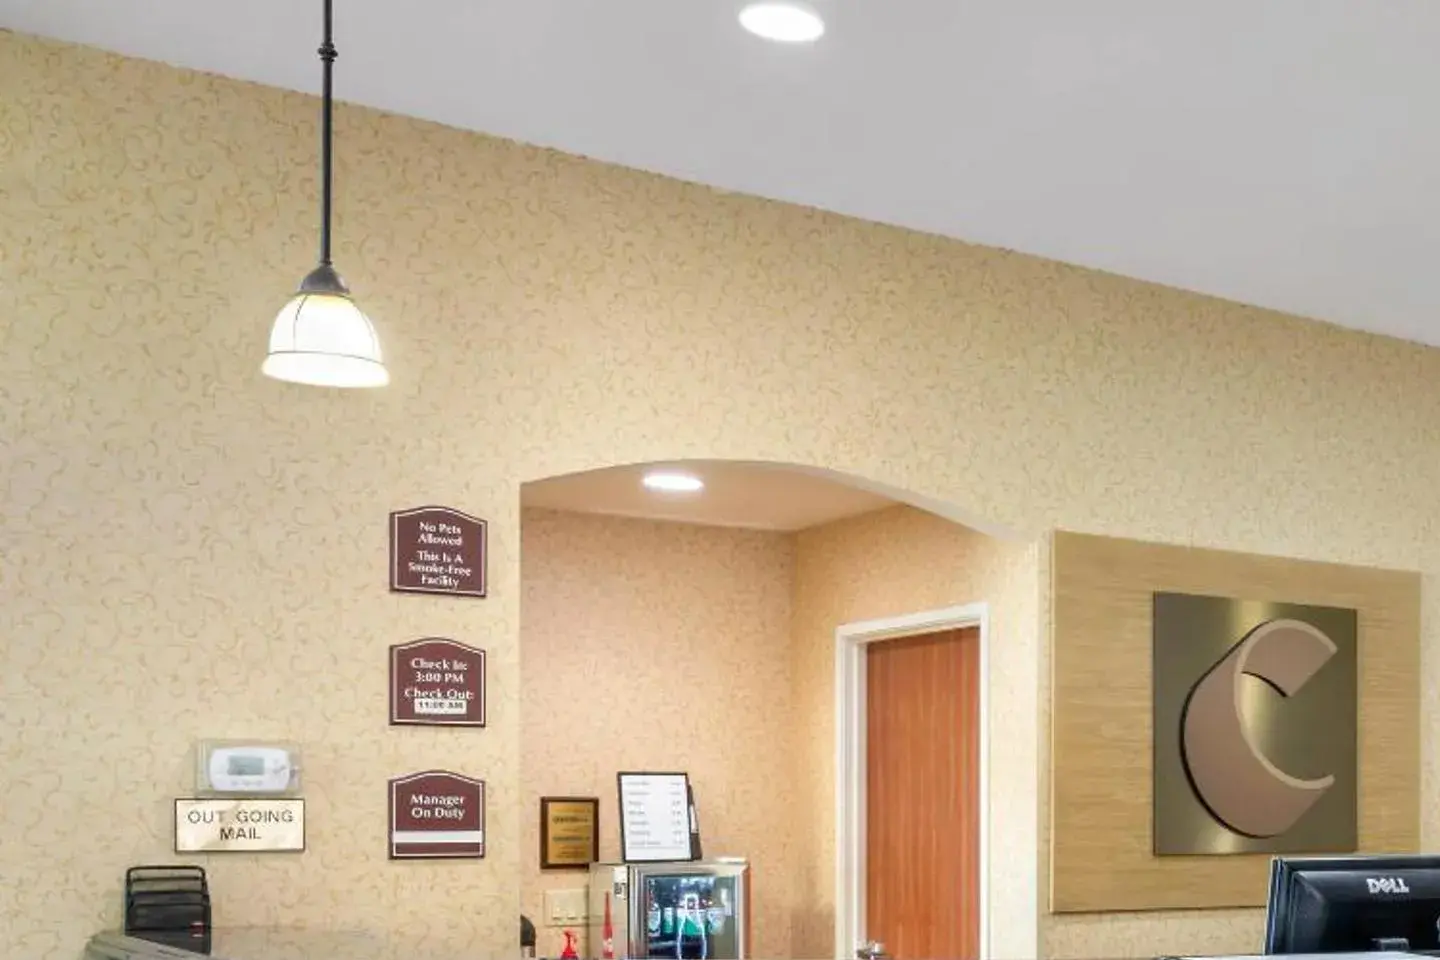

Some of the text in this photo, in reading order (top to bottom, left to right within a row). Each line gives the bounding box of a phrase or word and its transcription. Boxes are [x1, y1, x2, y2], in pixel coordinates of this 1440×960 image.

[420, 521, 462, 535] No Pets
[418, 533, 463, 546] Allowed
[417, 550, 464, 564] This Is A
[408, 562, 472, 576] Smoke-Free
[421, 574, 459, 587] Facility
[411, 657, 450, 670] Check
[415, 671, 464, 684] 3:00 PM
[404, 687, 442, 699] Check
[410, 794, 465, 807] Manager
[187, 809, 294, 824] OUT GOING
[411, 807, 466, 821] On Duty
[220, 827, 262, 840] MAIL
[1366, 878, 1410, 893] DELL
